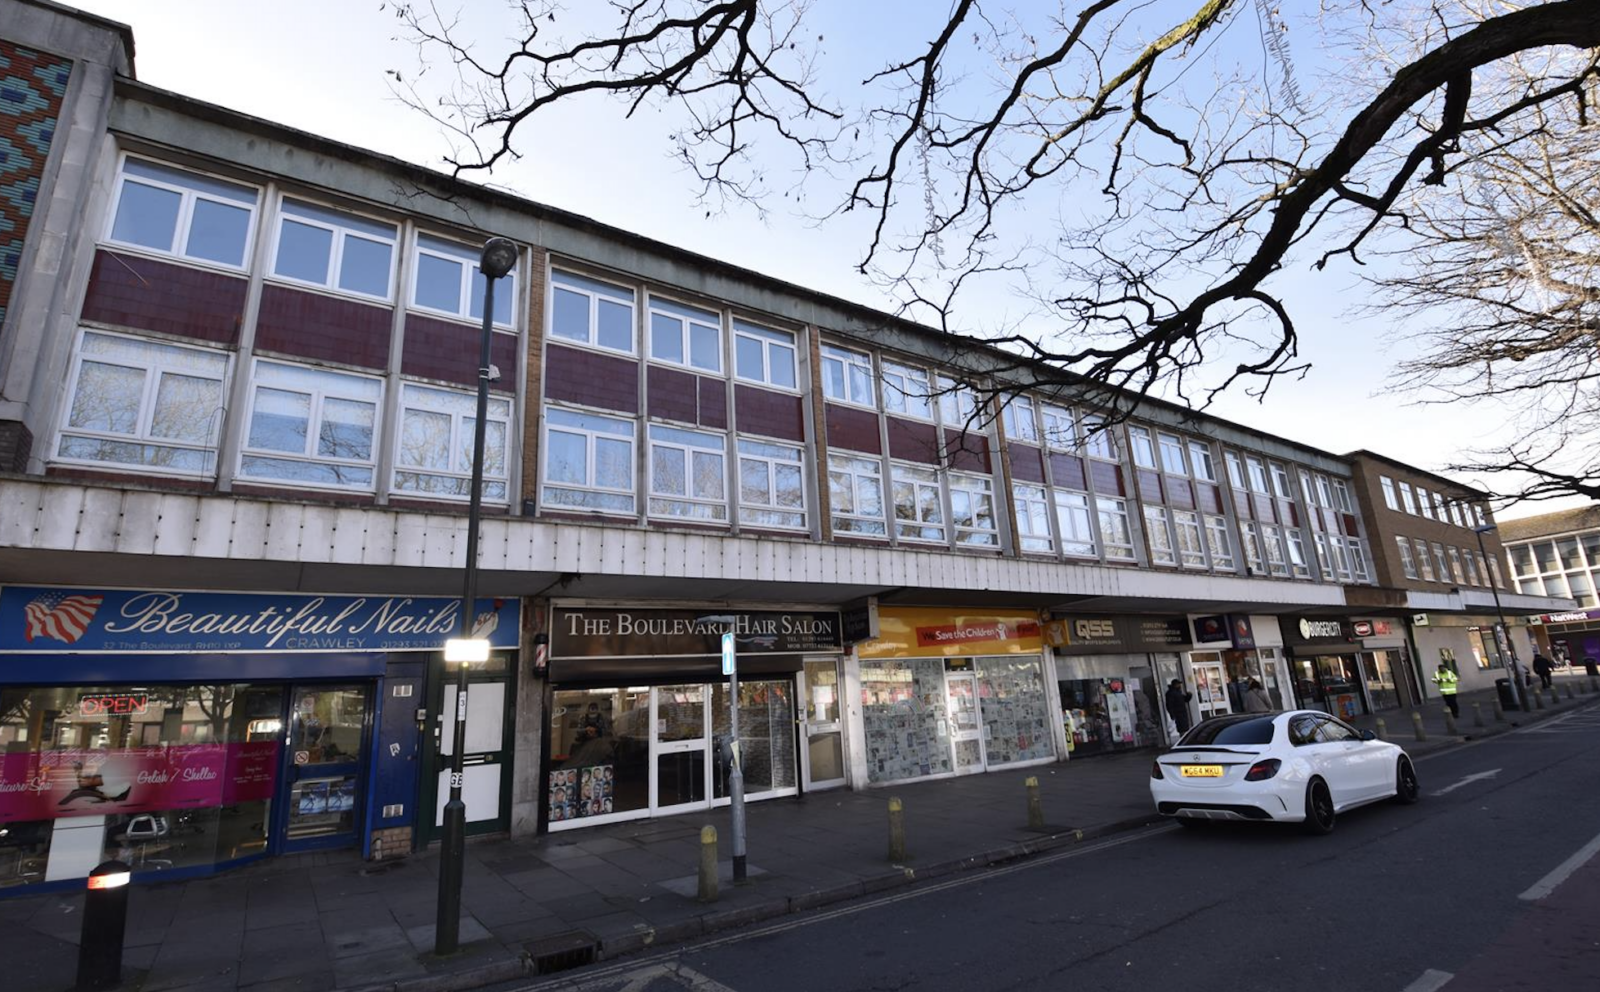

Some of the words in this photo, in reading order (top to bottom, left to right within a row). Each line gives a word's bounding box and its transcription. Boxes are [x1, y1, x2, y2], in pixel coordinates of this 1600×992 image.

[104, 592, 366, 648] Beautiful
[348, 598, 461, 634] Nails
[565, 613, 611, 636] THE
[735, 614, 778, 635] HAIR
[781, 615, 832, 635] SALON
[1550, 612, 1588, 622] NatWest
[935, 630, 954, 641] Save
[953, 630, 966, 639] the
[965, 628, 995, 638] Children
[1075, 619, 1115, 640] QSS
[119, 641, 138, 650] The
[285, 637, 366, 649] CRAWLEY
[380, 640, 410, 650] 01293
[82, 696, 147, 714] OPEN
[182, 766, 218, 781] Shellac
[28, 777, 53, 796] Spa
